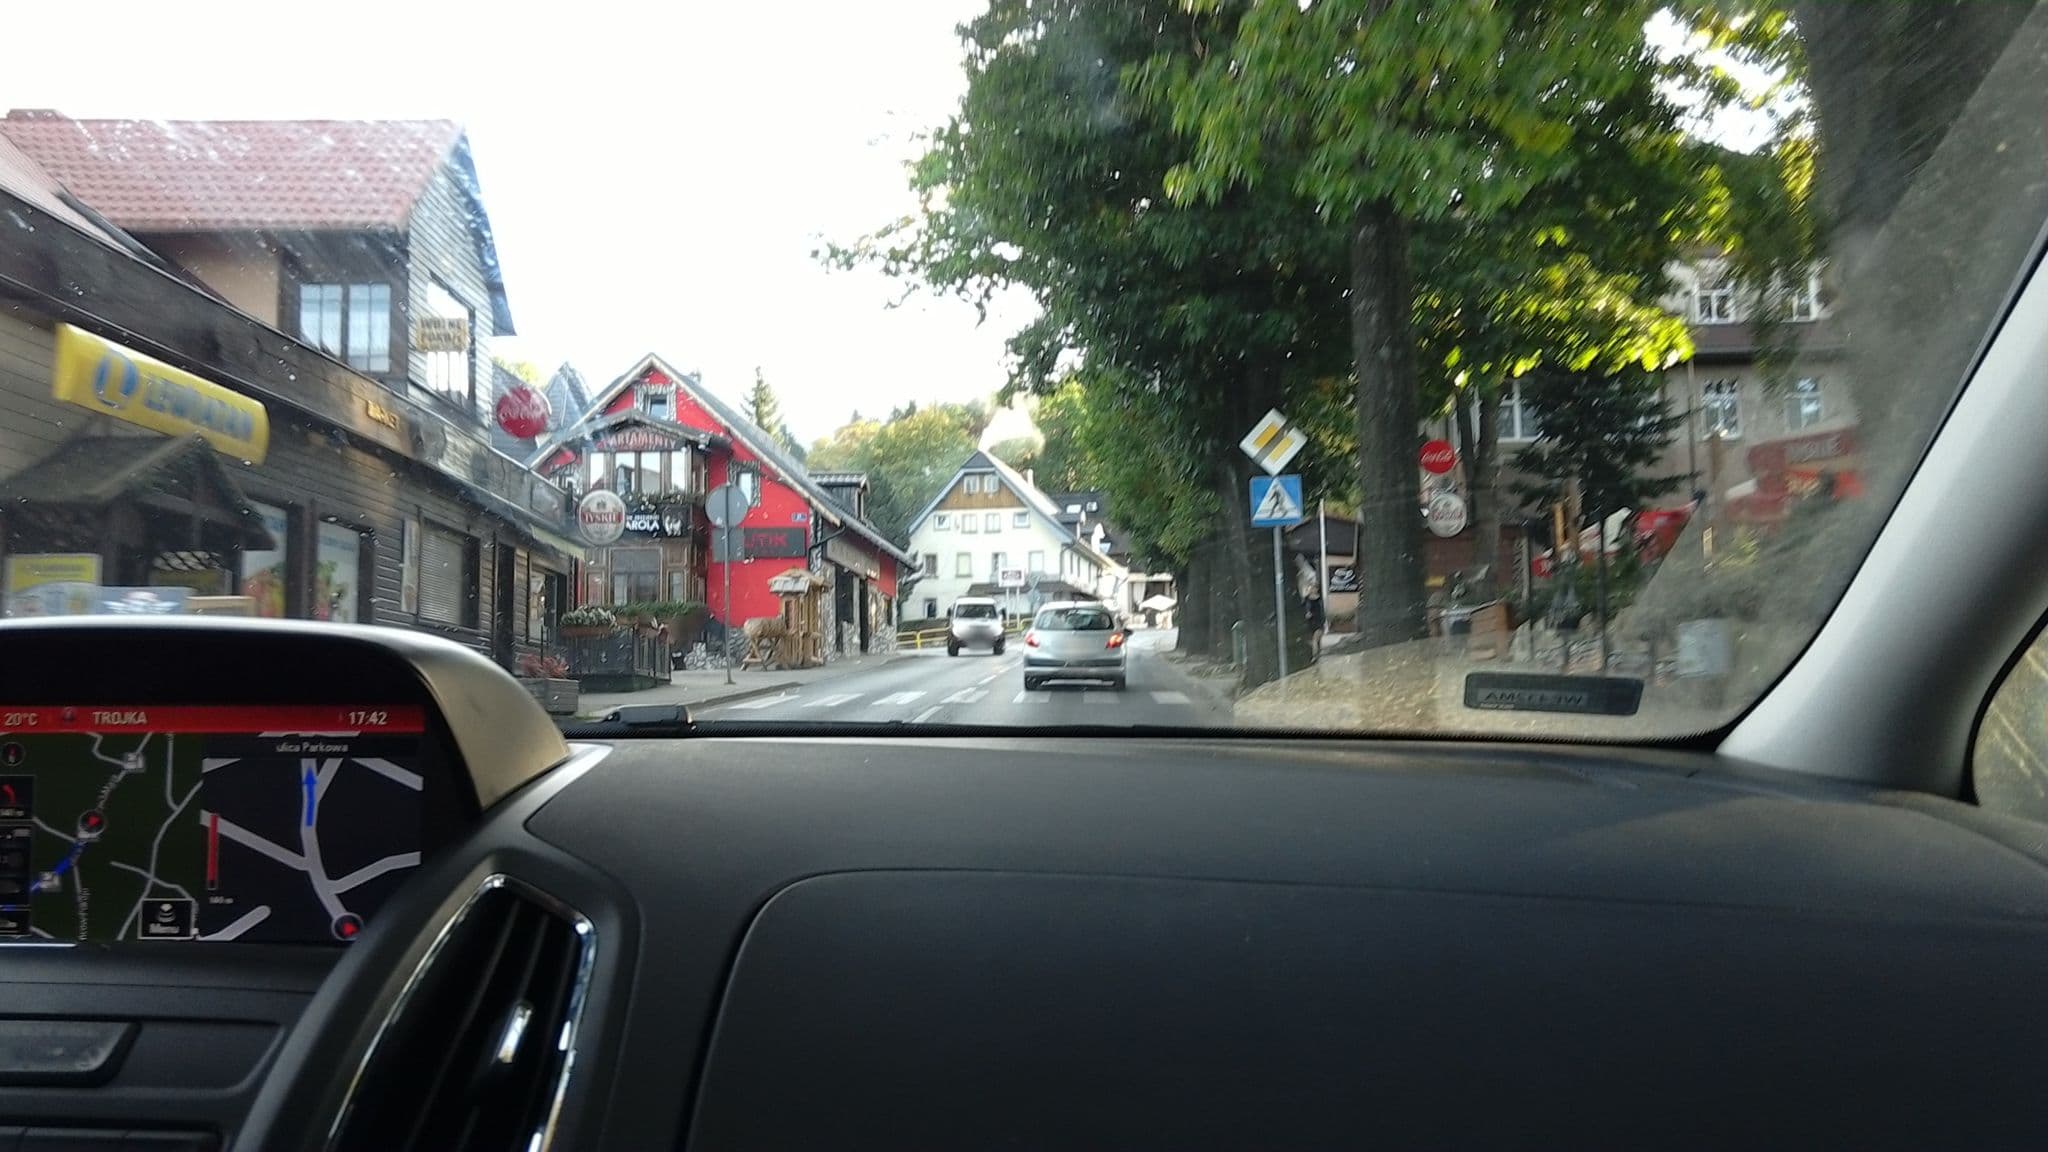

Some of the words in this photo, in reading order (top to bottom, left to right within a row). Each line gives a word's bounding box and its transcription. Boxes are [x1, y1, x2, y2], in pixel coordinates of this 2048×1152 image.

[4, 712, 38, 726] 20°C
[93, 711, 147, 724] TROJKA
[349, 711, 387, 725] 17:42
[276, 742, 300, 752] ulica
[302, 742, 348, 752] Parkowa
